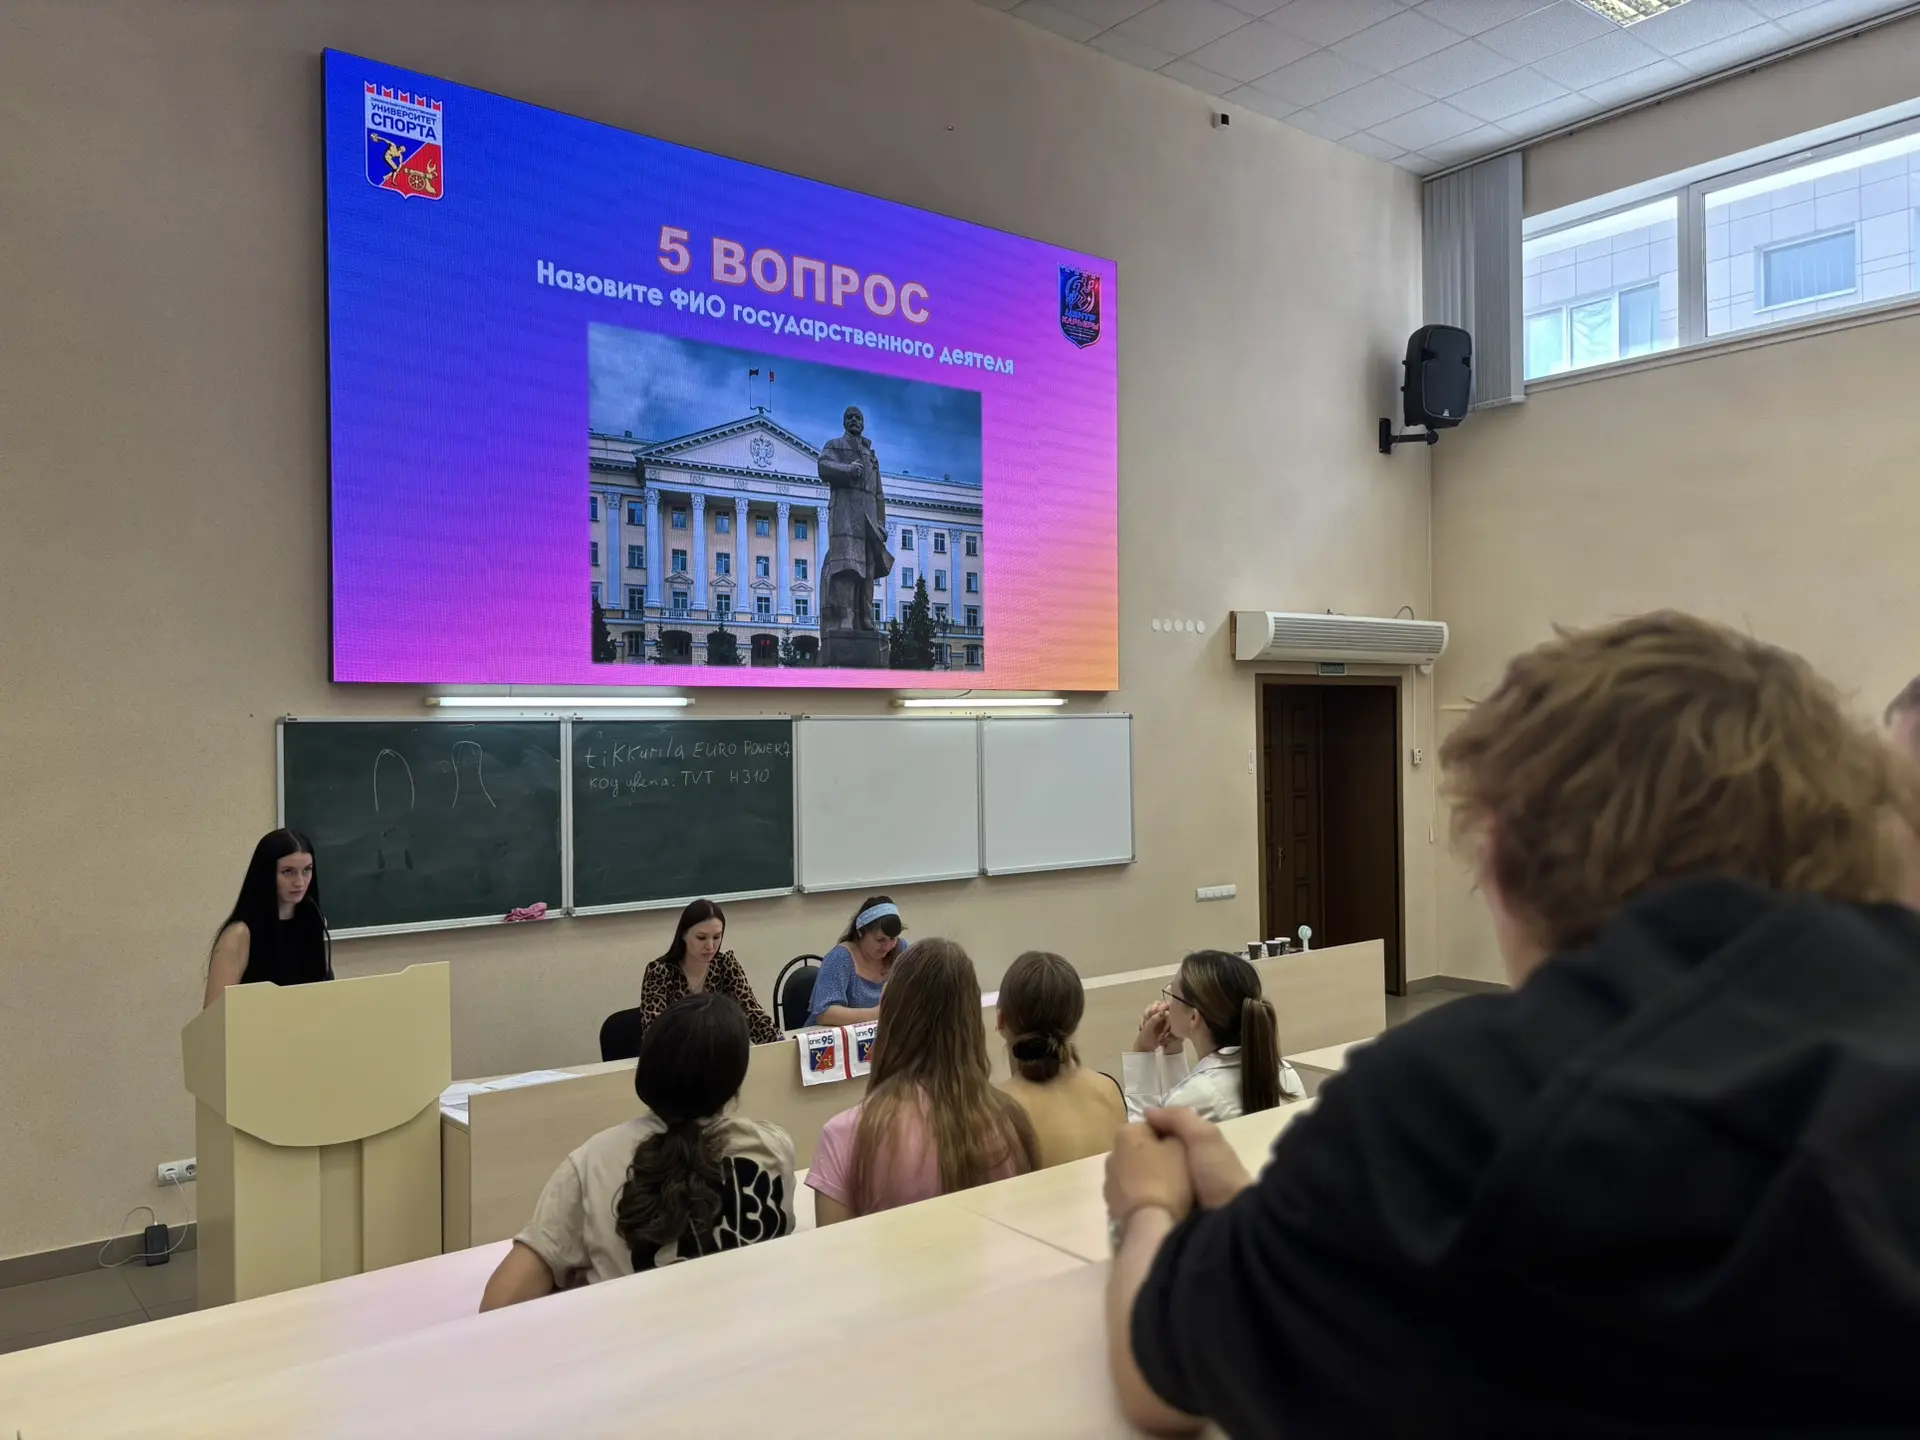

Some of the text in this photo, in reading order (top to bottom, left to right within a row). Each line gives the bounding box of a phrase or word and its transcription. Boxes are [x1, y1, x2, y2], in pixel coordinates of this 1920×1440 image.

[371, 103, 436, 126] УНИВЕРСИТЕТ
[371, 112, 437, 141] СПОРТА
[658, 225, 931, 325] 5 ВОПРОС
[537, 259, 1014, 375] Назовите ФИО государственного деятеля
[693, 741, 737, 758] EURO
[681, 769, 715, 787] TVT
[821, 1035, 834, 1045] 95
